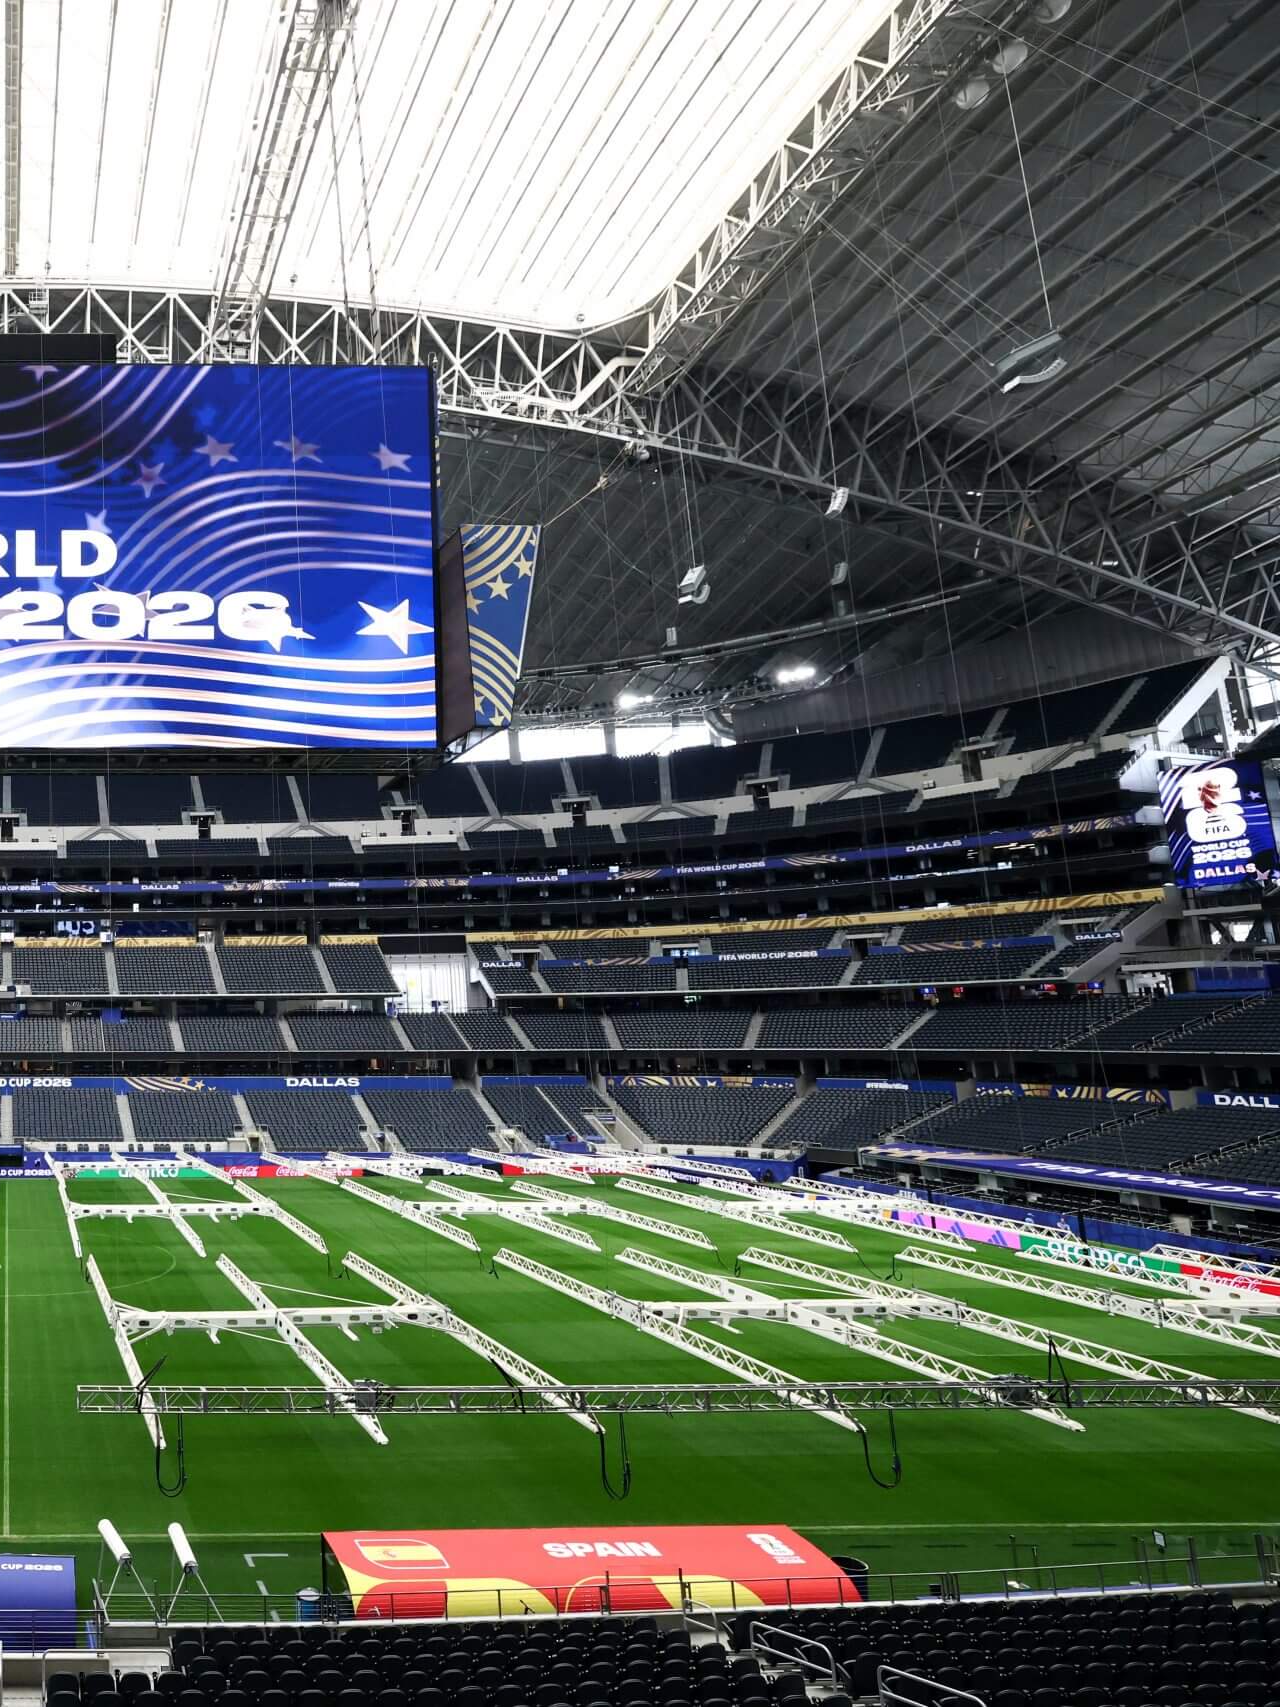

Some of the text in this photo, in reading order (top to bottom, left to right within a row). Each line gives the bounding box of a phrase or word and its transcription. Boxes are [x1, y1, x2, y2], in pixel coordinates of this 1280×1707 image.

[1205, 825, 1230, 835] FIFA
[905, 839, 962, 853] DALLAS
[1191, 838, 1251, 853] WORLD CUP
[1192, 846, 1253, 864] 2026
[676, 866, 693, 875] FIFA
[693, 865, 721, 873] WORLD
[721, 863, 738, 871] CUP
[1194, 863, 1257, 879] DALLAS
[516, 875, 558, 883] DALLAS
[1074, 932, 1121, 941] DALLAS
[768, 951, 786, 959] CUP
[786, 950, 818, 958] 2026
[8, 1078, 31, 1088] CUP
[32, 1078, 73, 1088] 2026
[286, 1077, 360, 1088] DALLAS
[1096, 1170, 1249, 1193] WORLD
[542, 1541, 663, 1558] SPAIN
[0, 1563, 23, 1571] CUP
